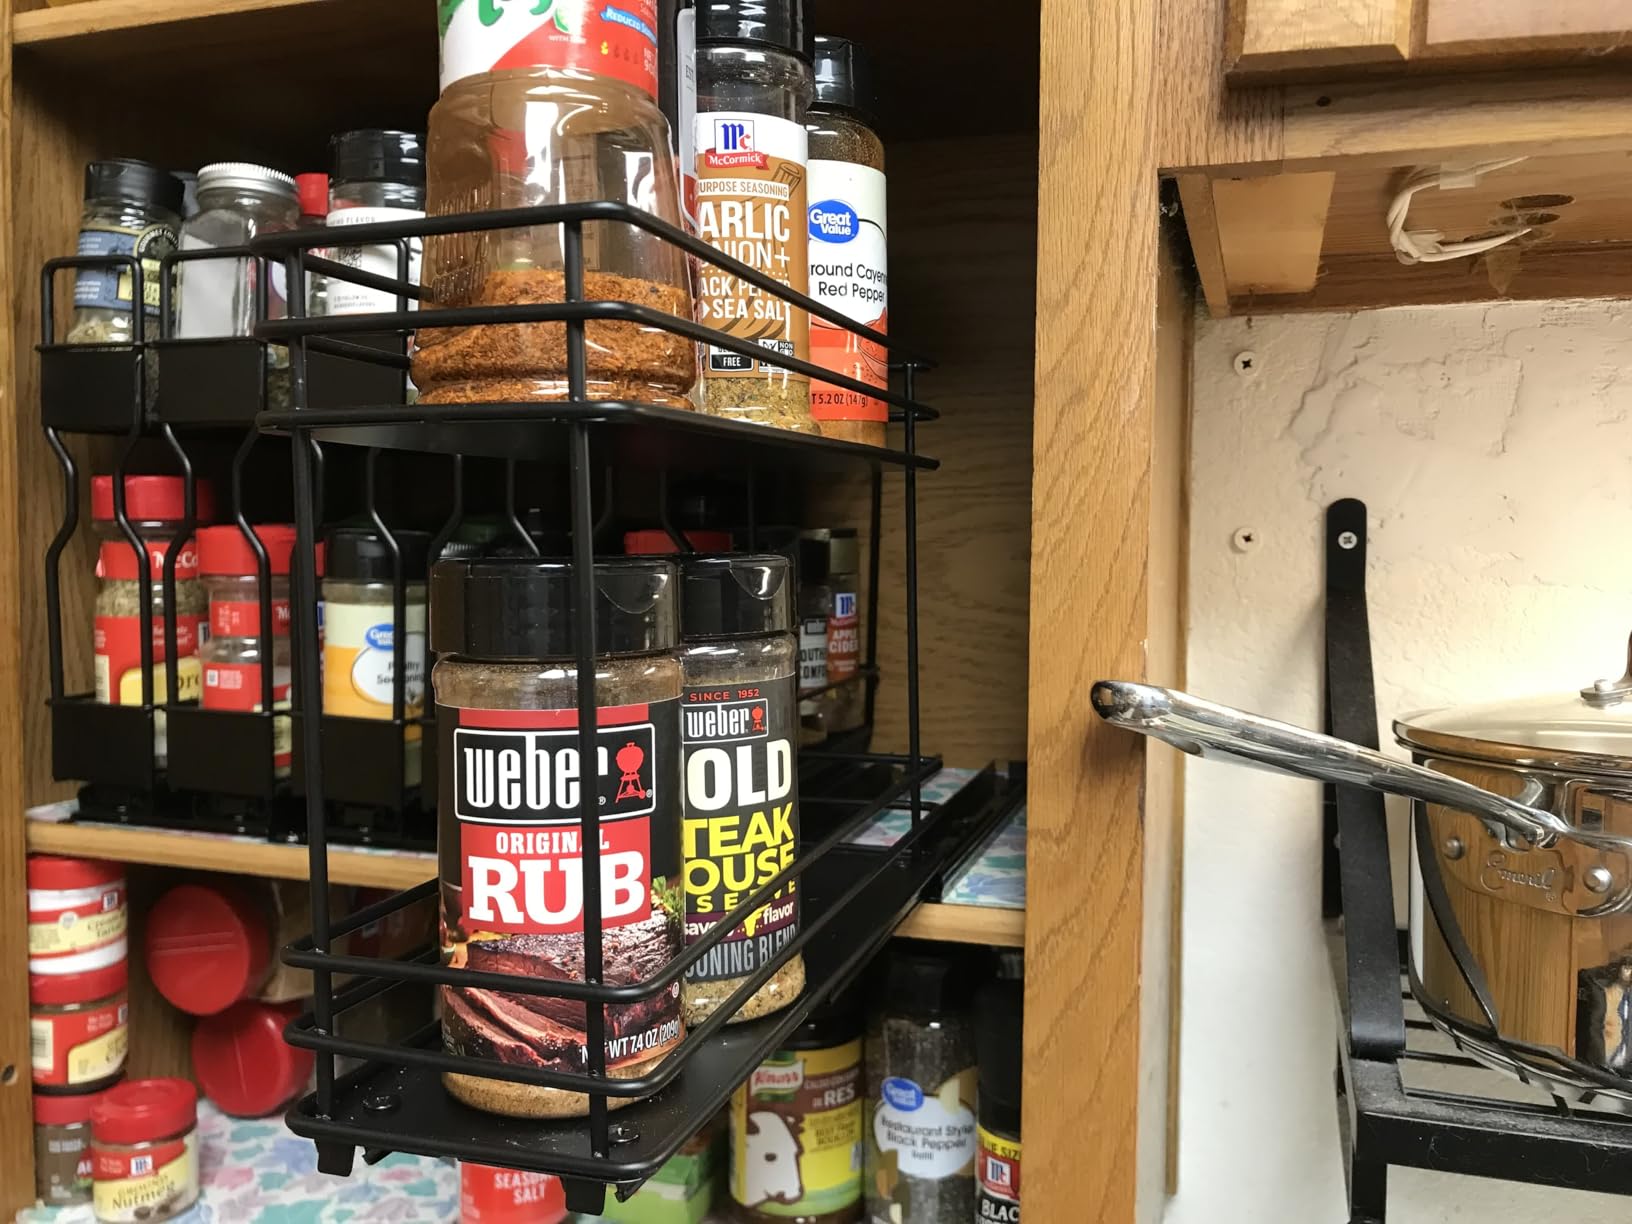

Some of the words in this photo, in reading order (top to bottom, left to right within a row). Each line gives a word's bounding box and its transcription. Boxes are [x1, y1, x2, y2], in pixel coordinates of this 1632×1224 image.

[709, 153, 762, 166] McCormick
[740, 182, 788, 199] SEASONING
[810, 208, 851, 226] Great
[820, 223, 851, 236] Value
[818, 281, 848, 297] Red
[852, 283, 885, 304] Pepper
[712, 299, 748, 319] SEA
[753, 300, 791, 321] SALT
[723, 356, 741, 367] FREE
[818, 393, 832, 405] 5.2
[834, 393, 844, 405] OZ
[690, 691, 730, 702] SINCE
[738, 688, 760, 699] 1952
[686, 704, 750, 738] weber
[687, 738, 792, 811] OLD
[683, 801, 794, 858] TEAK
[495, 828, 610, 855] ORIGINL
[467, 850, 646, 926] RUB
[763, 901, 794, 926] flavor
[608, 1037, 630, 1059] WT
[630, 1034, 644, 1054] 7.4
[645, 1028, 658, 1049] OZ
[824, 1082, 856, 1107] RES
[513, 1187, 546, 1205] SALT
[981, 1198, 1020, 1222] BLAC
